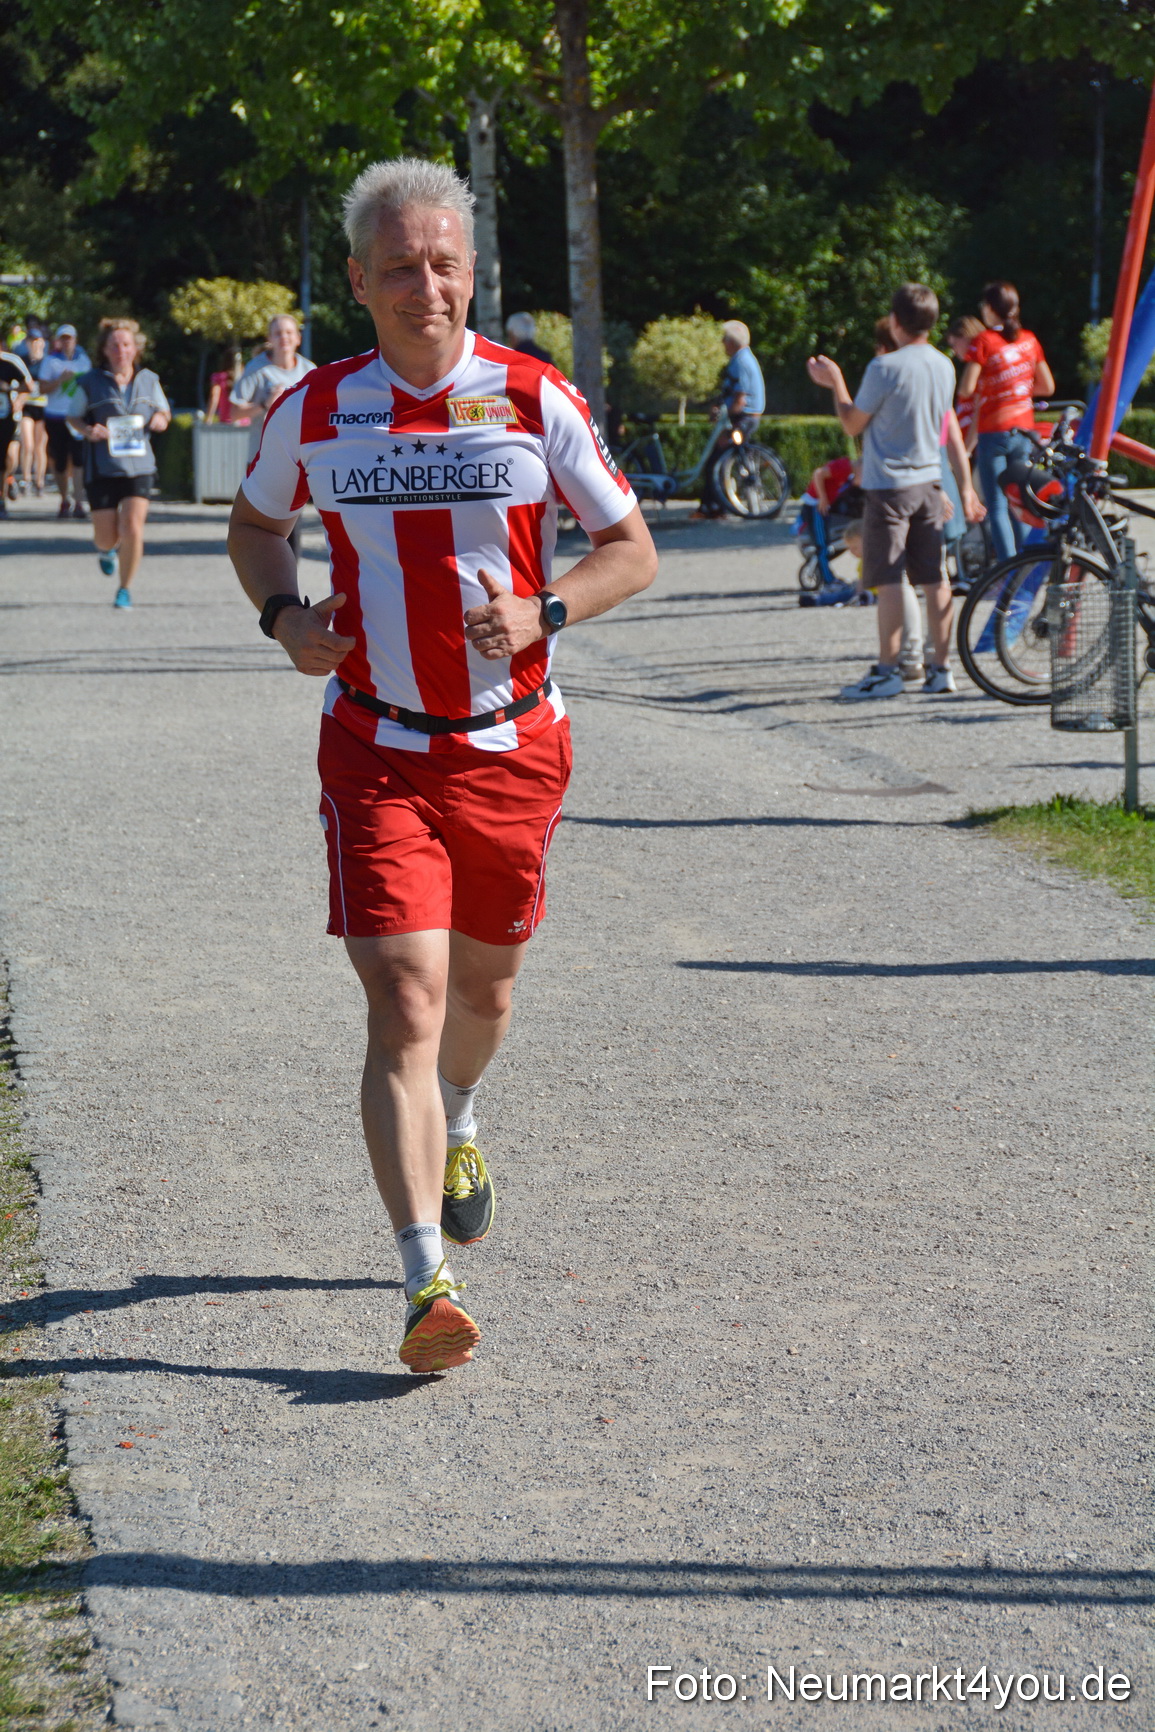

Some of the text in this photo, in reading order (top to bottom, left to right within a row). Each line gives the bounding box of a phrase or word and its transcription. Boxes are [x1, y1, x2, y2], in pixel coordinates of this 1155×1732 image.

[330, 411, 393, 425] macron
[485, 405, 513, 418] UNION
[378, 493, 462, 503] NEWTRITIONSTYLE
